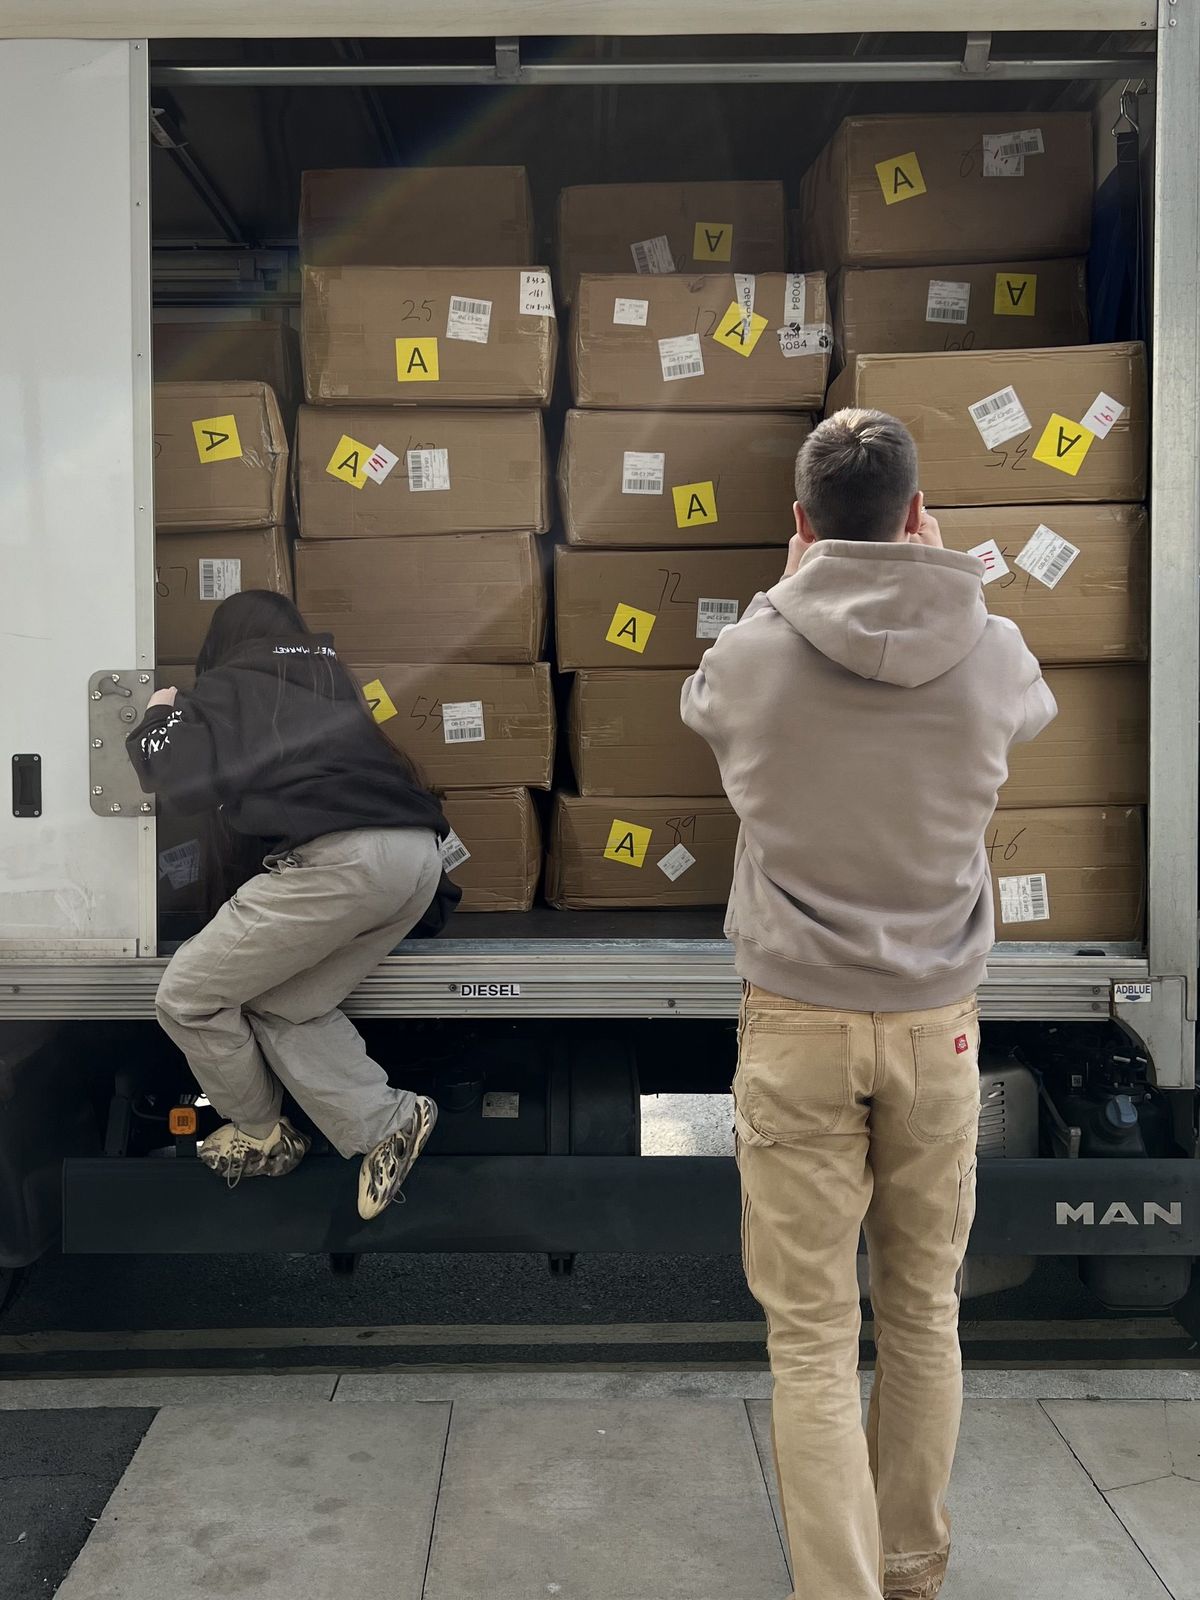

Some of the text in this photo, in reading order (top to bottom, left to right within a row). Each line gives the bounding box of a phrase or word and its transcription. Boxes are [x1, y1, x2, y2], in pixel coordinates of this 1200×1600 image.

[893, 166, 914, 194] A
[704, 229, 724, 252] A
[791, 281, 801, 310] 0084
[1006, 280, 1027, 306] A
[401, 299, 437, 322] 25
[693, 306, 717, 337] 12
[725, 318, 747, 346] A
[407, 347, 428, 374] A
[202, 429, 230, 452] A
[1056, 426, 1082, 458] A
[337, 450, 360, 478] A
[687, 493, 708, 520] A
[657, 568, 699, 612] 72
[616, 616, 637, 643] A
[272, 645, 310, 654] MARKET
[665, 814, 697, 846] 89
[614, 831, 634, 858] A
[461, 984, 520, 996] DIESEL
[1115, 985, 1151, 994] ADBLUE
[1056, 1201, 1182, 1225] MAN
